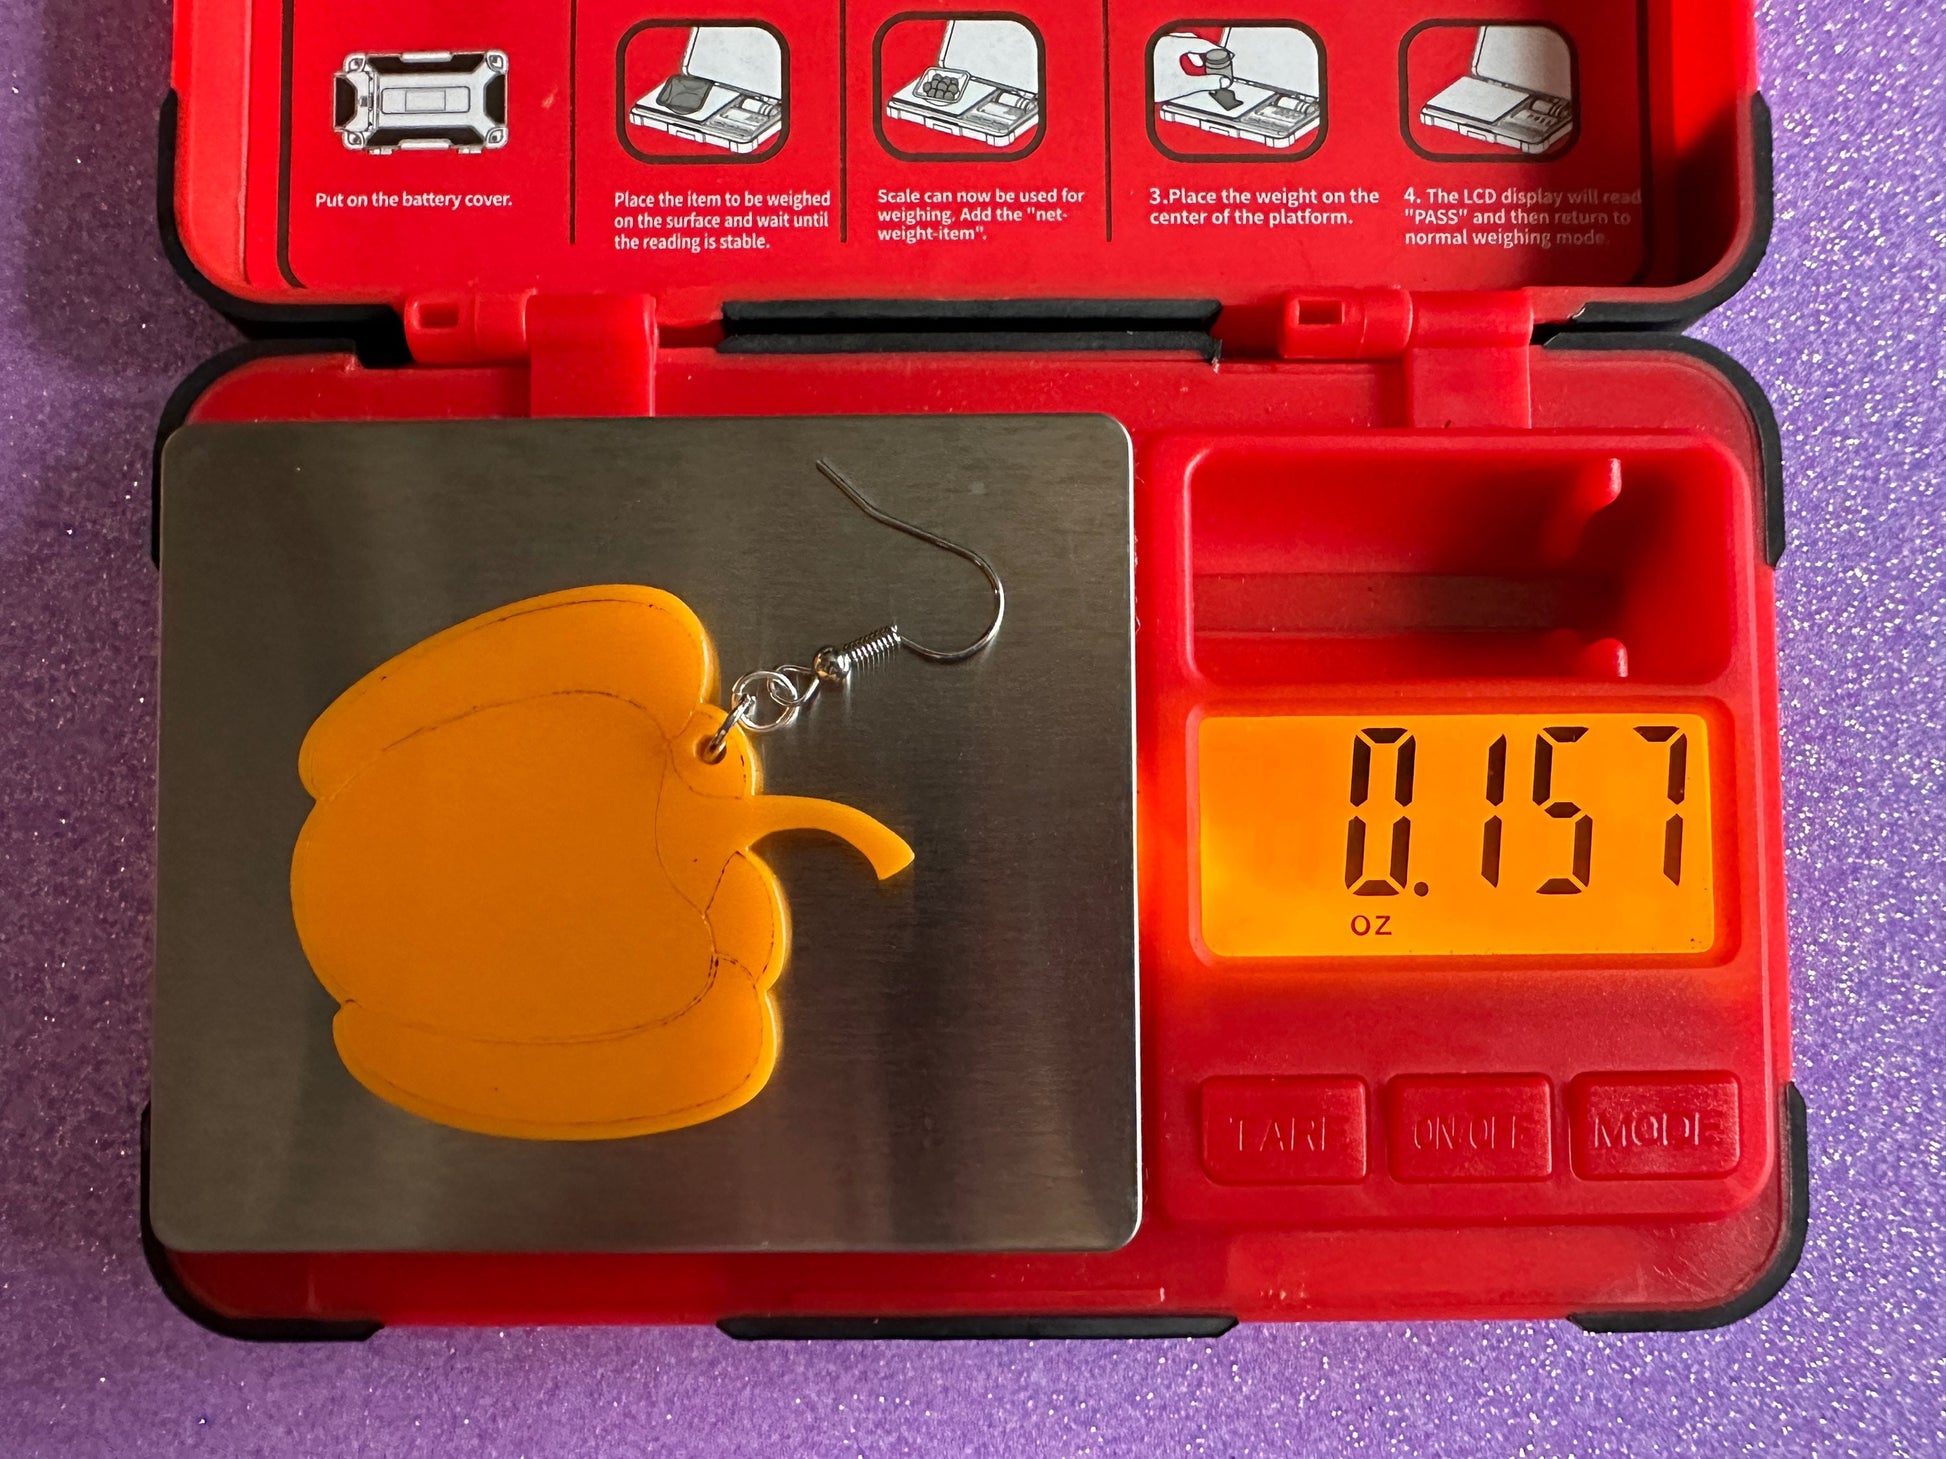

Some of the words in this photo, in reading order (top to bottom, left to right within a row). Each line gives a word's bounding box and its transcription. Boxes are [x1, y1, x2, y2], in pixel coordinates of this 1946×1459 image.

[316, 192, 344, 207] Put
[347, 194, 368, 207] on
[372, 191, 399, 207] the
[402, 191, 462, 210] battery
[465, 194, 513, 207] cover.
[614, 192, 655, 207] Place
[658, 191, 683, 207] the
[687, 190, 721, 207] item
[725, 192, 740, 207] to
[744, 191, 763, 207] be
[767, 190, 831, 210] weighed
[877, 188, 920, 203] Scale
[924, 191, 953, 203] can
[956, 191, 991, 203] now
[995, 188, 1015, 203] be
[1019, 188, 1057, 203] used
[1061, 188, 1086, 203] for
[1221, 188, 1251, 204] the
[1256, 187, 1318, 207] weight
[1322, 191, 1345, 204] on
[1349, 187, 1380, 204] the
[1403, 187, 1422, 204] 4.
[1426, 188, 1459, 204] The
[1463, 188, 1497, 204] LCD
[1501, 187, 1564, 208] display
[1567, 189, 1599, 205] will
[1602, 188, 1643, 205] read
[614, 215, 634, 228] on
[637, 212, 662, 228] the
[666, 212, 721, 228] surface
[724, 211, 753, 228] and
[757, 211, 790, 228] wait
[793, 211, 829, 228] until
[960, 206, 992, 222] Add
[996, 207, 1023, 222] the
[1150, 209, 1208, 225] center
[1212, 208, 1231, 225] of
[1234, 208, 1265, 225] the
[1269, 208, 1354, 228] platform.
[1404, 208, 1468, 225] "PASS"
[1472, 208, 1506, 225] and
[1510, 209, 1549, 225] then
[1554, 210, 1609, 225] return
[1612, 211, 1632, 225] to
[614, 234, 640, 250] the
[643, 233, 701, 253] reading
[704, 233, 717, 249] is
[720, 233, 770, 249] stable.
[1405, 229, 1468, 245] normal
[1472, 228, 1551, 249] weighing
[1344, 726, 1687, 897] 0.157
